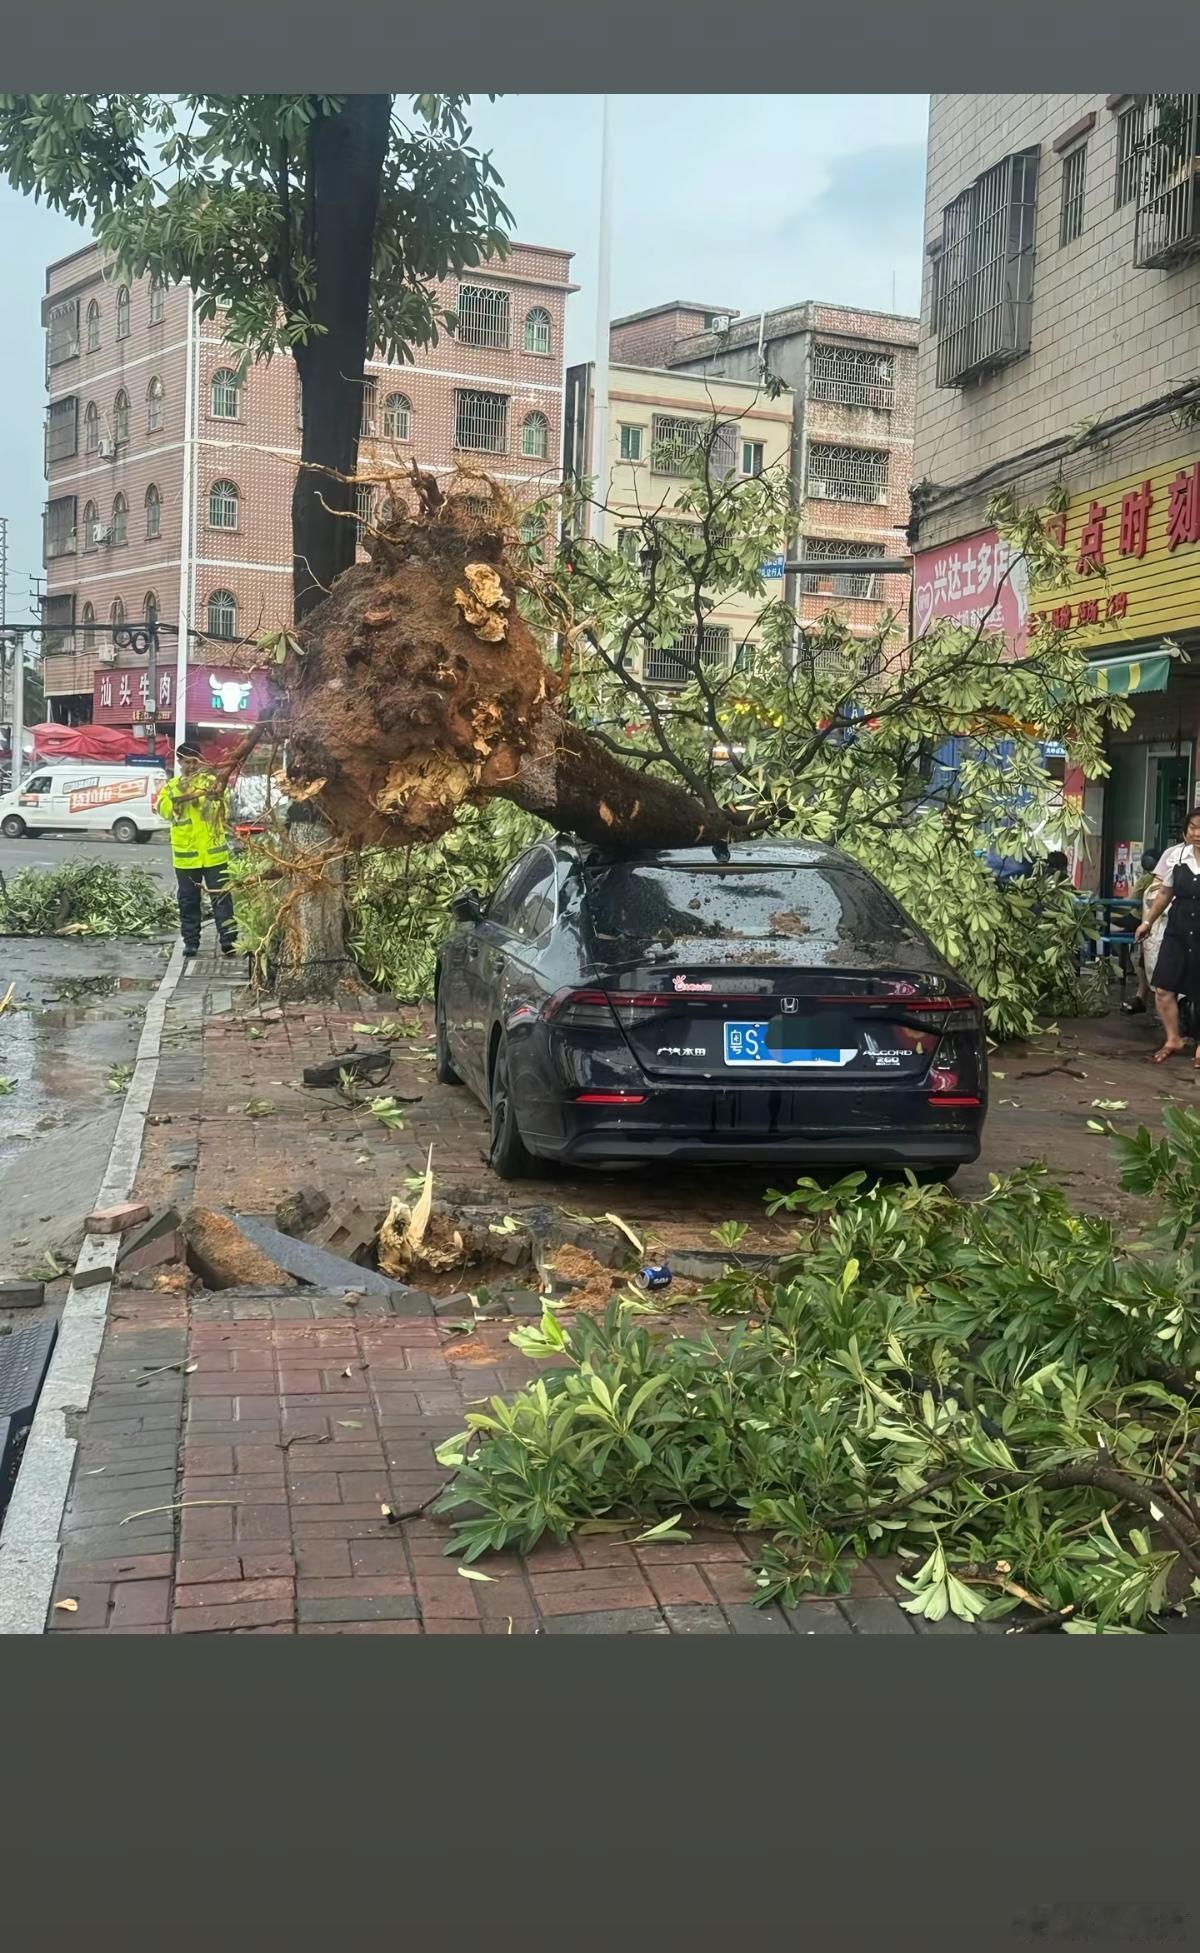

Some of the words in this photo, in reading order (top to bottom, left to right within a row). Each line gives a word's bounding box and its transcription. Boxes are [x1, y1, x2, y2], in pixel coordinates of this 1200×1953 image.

[933, 540, 1009, 605] 兴达士多店
